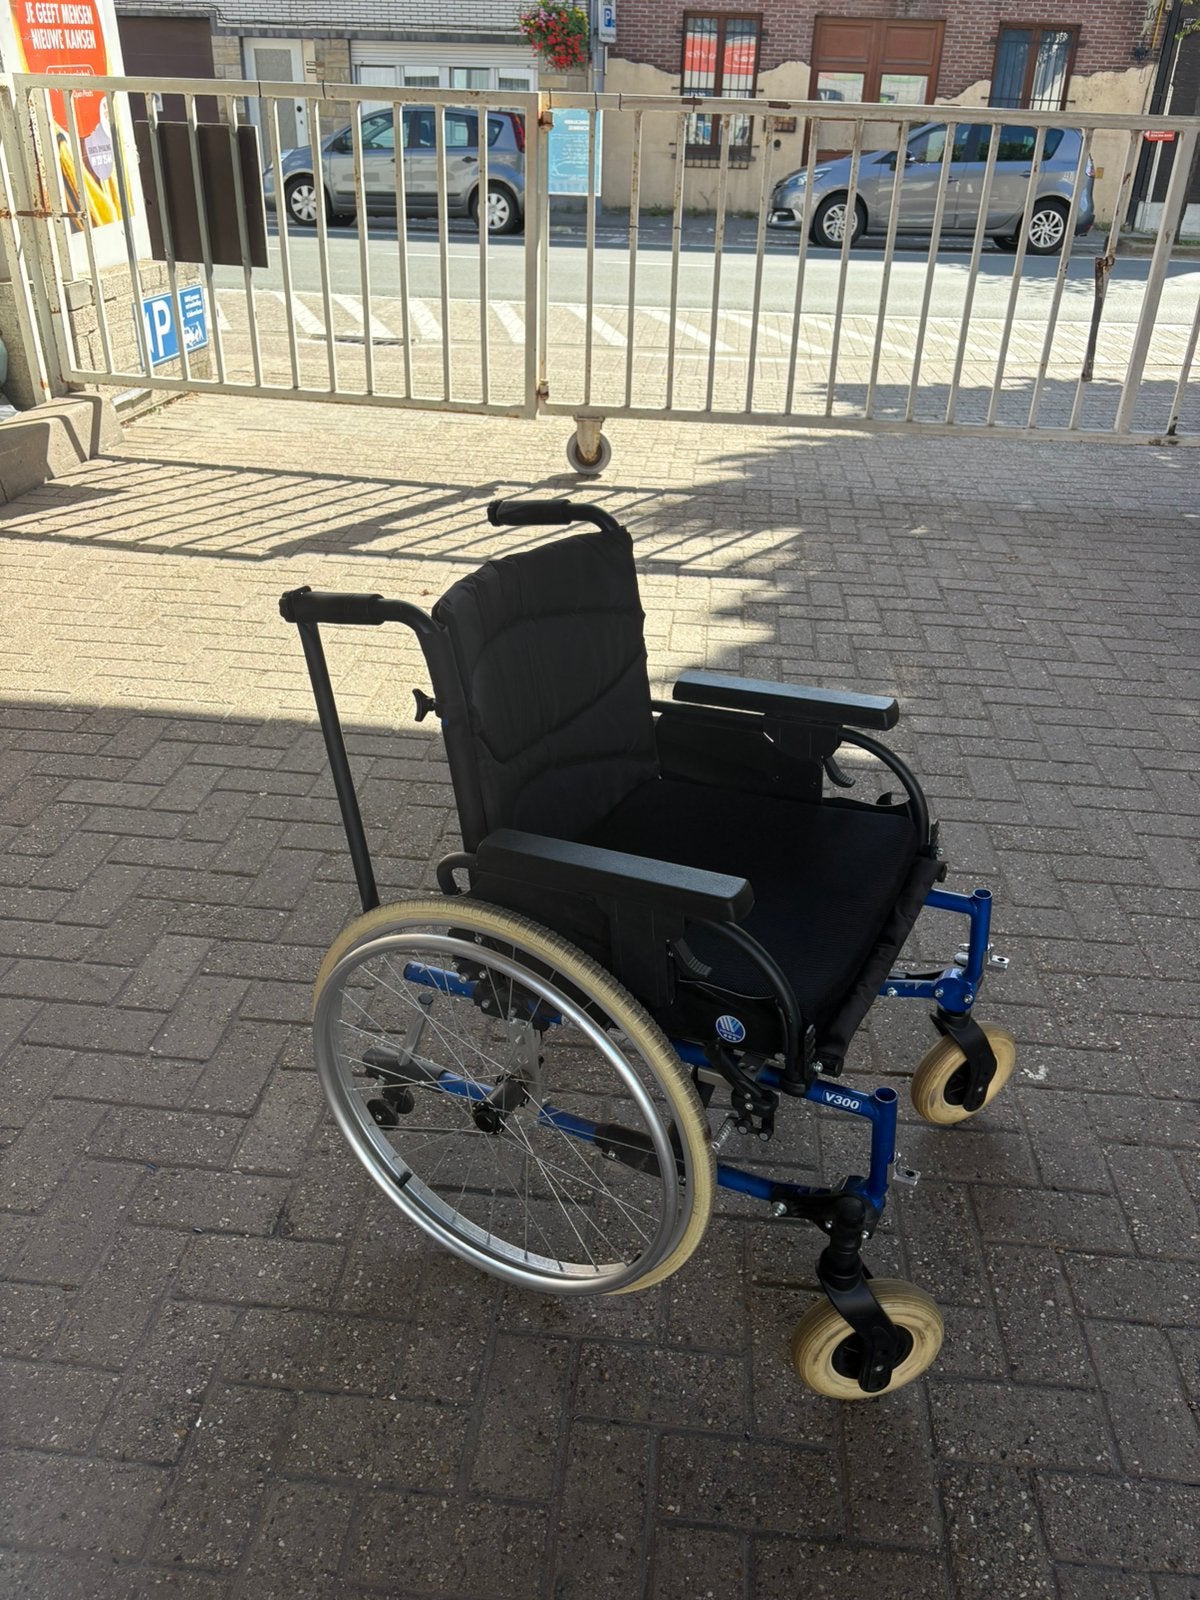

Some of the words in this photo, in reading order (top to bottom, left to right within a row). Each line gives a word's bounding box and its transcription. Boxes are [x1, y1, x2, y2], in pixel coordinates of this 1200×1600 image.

[25, 2, 35, 23] JE
[35, 2, 60, 24] GEEFT
[61, 4, 94, 25] MENSEN
[605, 10, 611, 26] P
[31, 28, 64, 49] NIEUWE
[64, 29, 96, 49] KANSEN
[152, 300, 171, 357] P
[826, 1092, 859, 1109] V300
